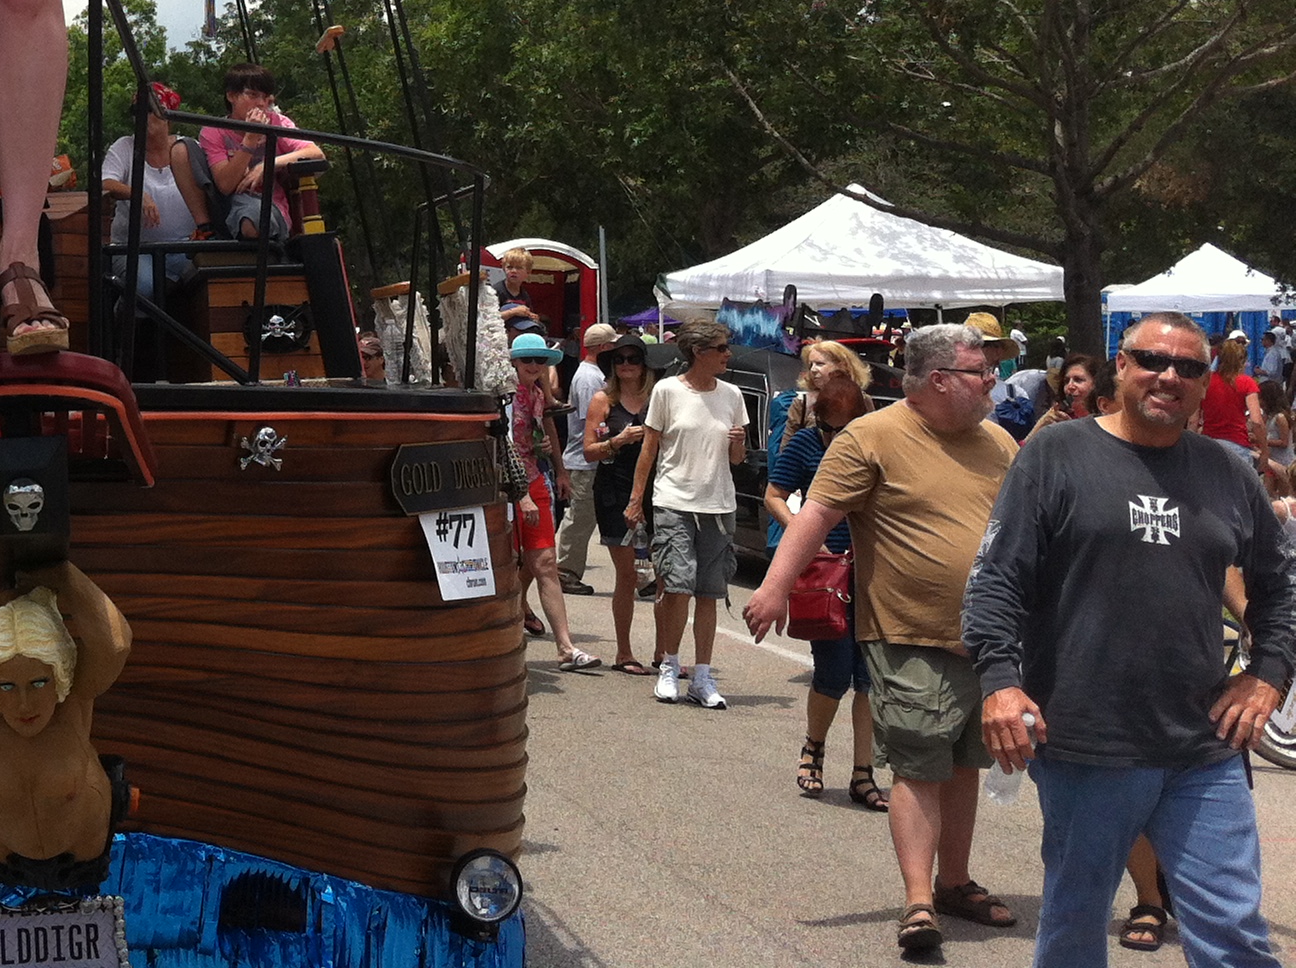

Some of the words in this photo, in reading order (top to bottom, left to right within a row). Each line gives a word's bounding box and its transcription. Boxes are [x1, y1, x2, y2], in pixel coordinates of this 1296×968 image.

[400, 461, 442, 496] GOLD
[452, 458, 495, 489] DIGGER
[435, 511, 476, 549] #77
[1132, 508, 1178, 531] CHOPPERS
